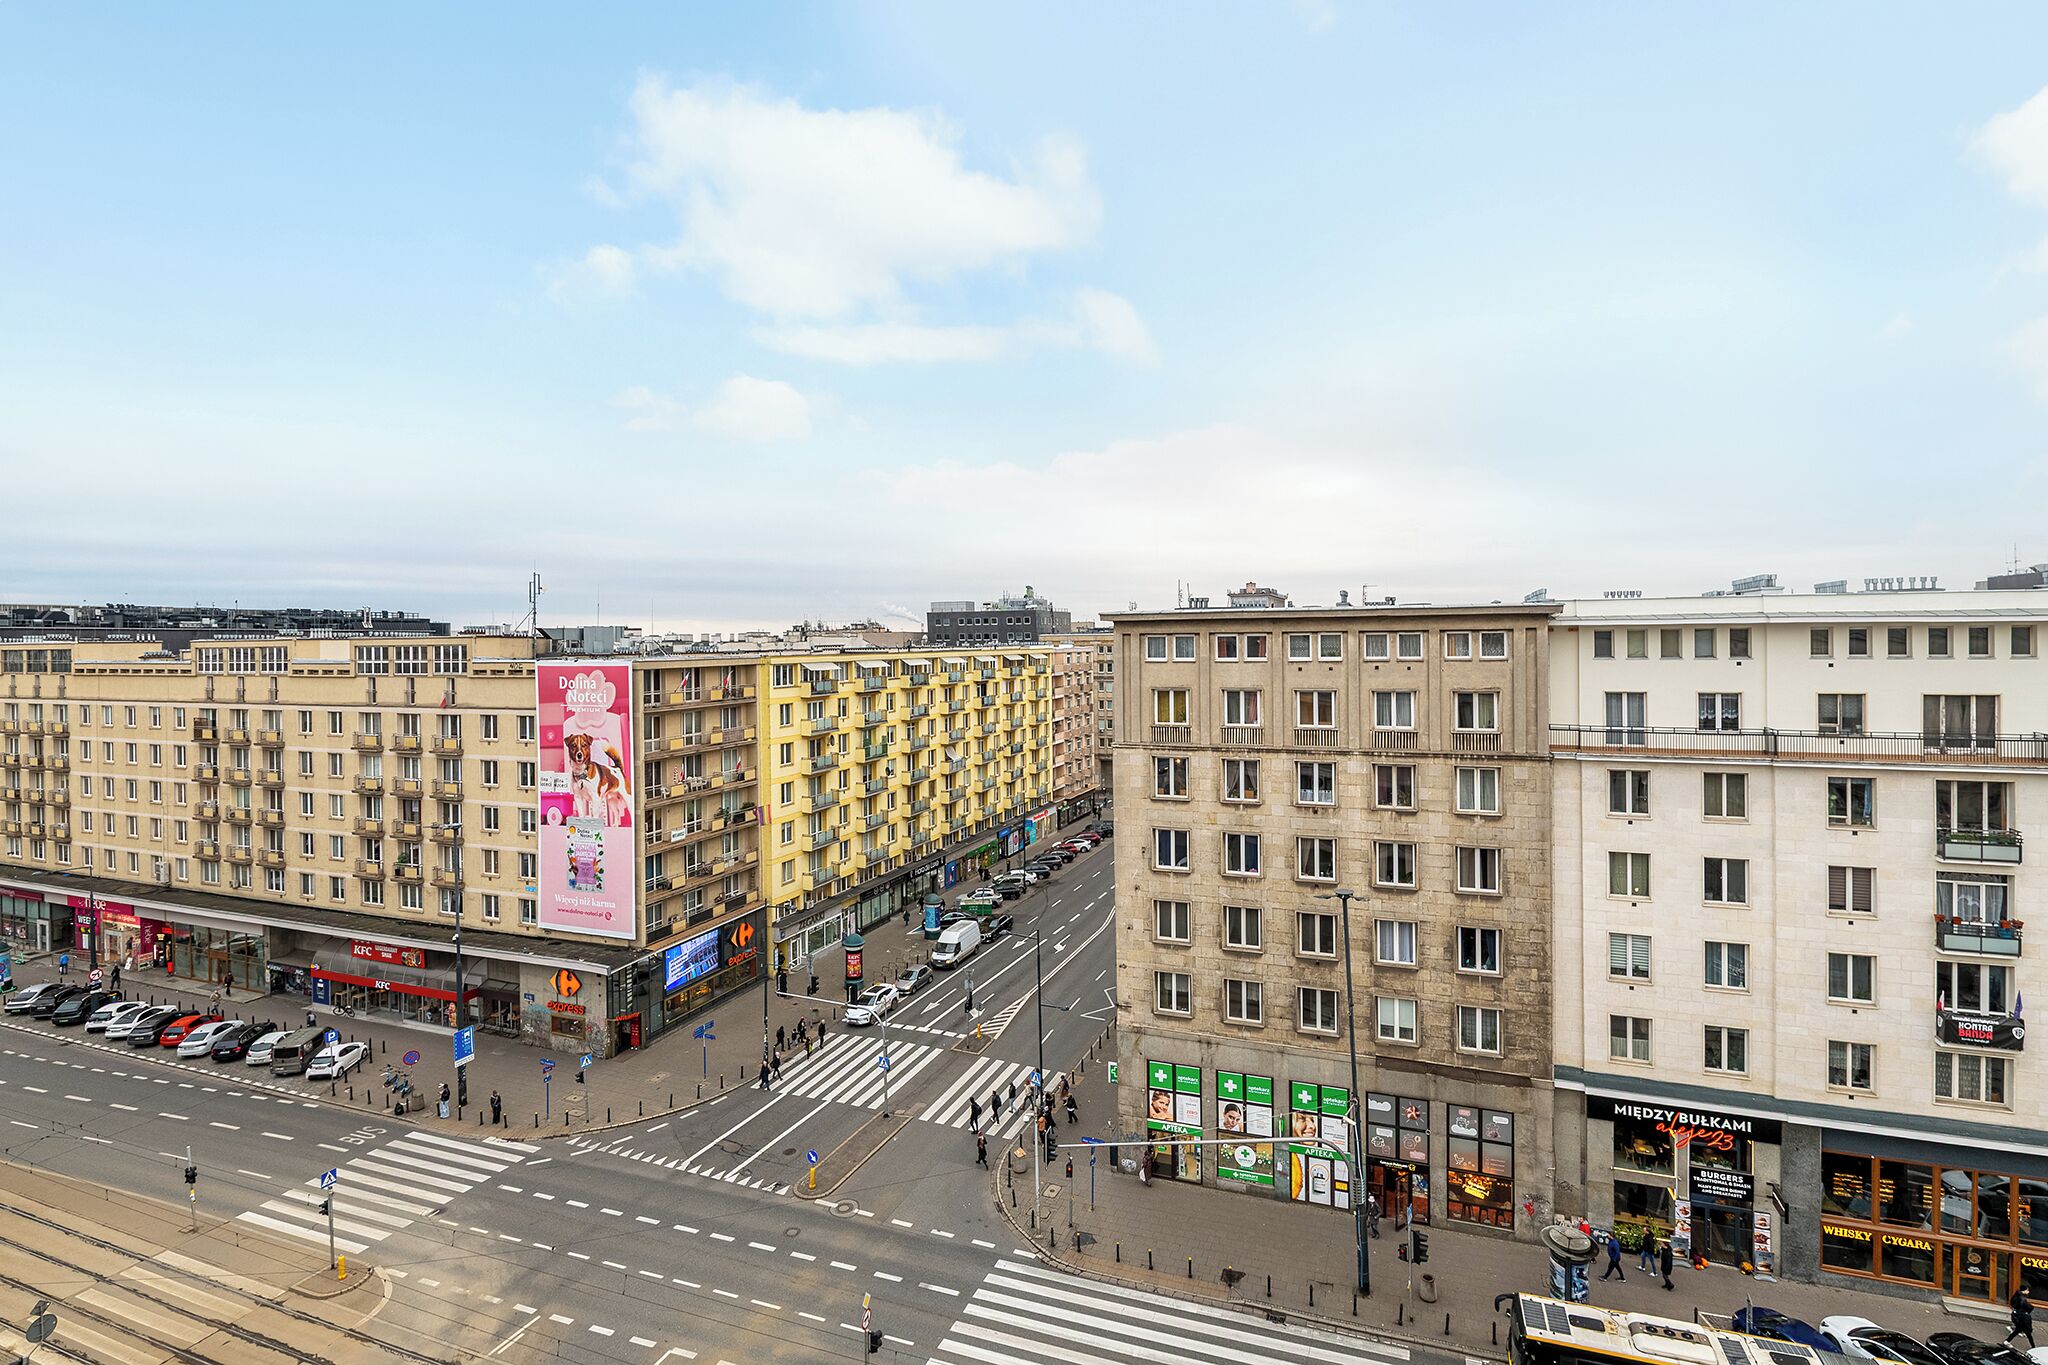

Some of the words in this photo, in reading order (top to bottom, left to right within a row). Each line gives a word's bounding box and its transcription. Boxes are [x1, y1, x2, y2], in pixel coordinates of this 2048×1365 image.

[559, 676, 596, 689] Dolina
[567, 689, 607, 703] Noteci
[555, 893, 579, 906] Więcej
[580, 897, 590, 906] niż
[591, 898, 616, 908] karma
[353, 944, 372, 957] KFC
[728, 947, 758, 966] express
[375, 981, 390, 990] KFC
[546, 1000, 586, 1015] express
[1958, 1021, 1993, 1032] KONTRA
[328, 1031, 336, 1041] P
[1958, 1029, 1993, 1040] BANDA
[1614, 1104, 1675, 1121] MIĘDZY
[1679, 1112, 1752, 1133] BUŁKAMI
[338, 1126, 387, 1145] BUS
[1161, 1124, 1188, 1134] APTEKA
[1305, 1148, 1335, 1158] APTEKA
[1693, 1176, 1728, 1185] TRADITIONAL
[1701, 1170, 1743, 1183] BURGERS
[1713, 1190, 1743, 1198] BREAKFASTS
[1823, 1225, 1872, 1242] WHISKY
[1882, 1234, 1932, 1251] CYGARA
[2020, 1256, 2048, 1269] CYG
